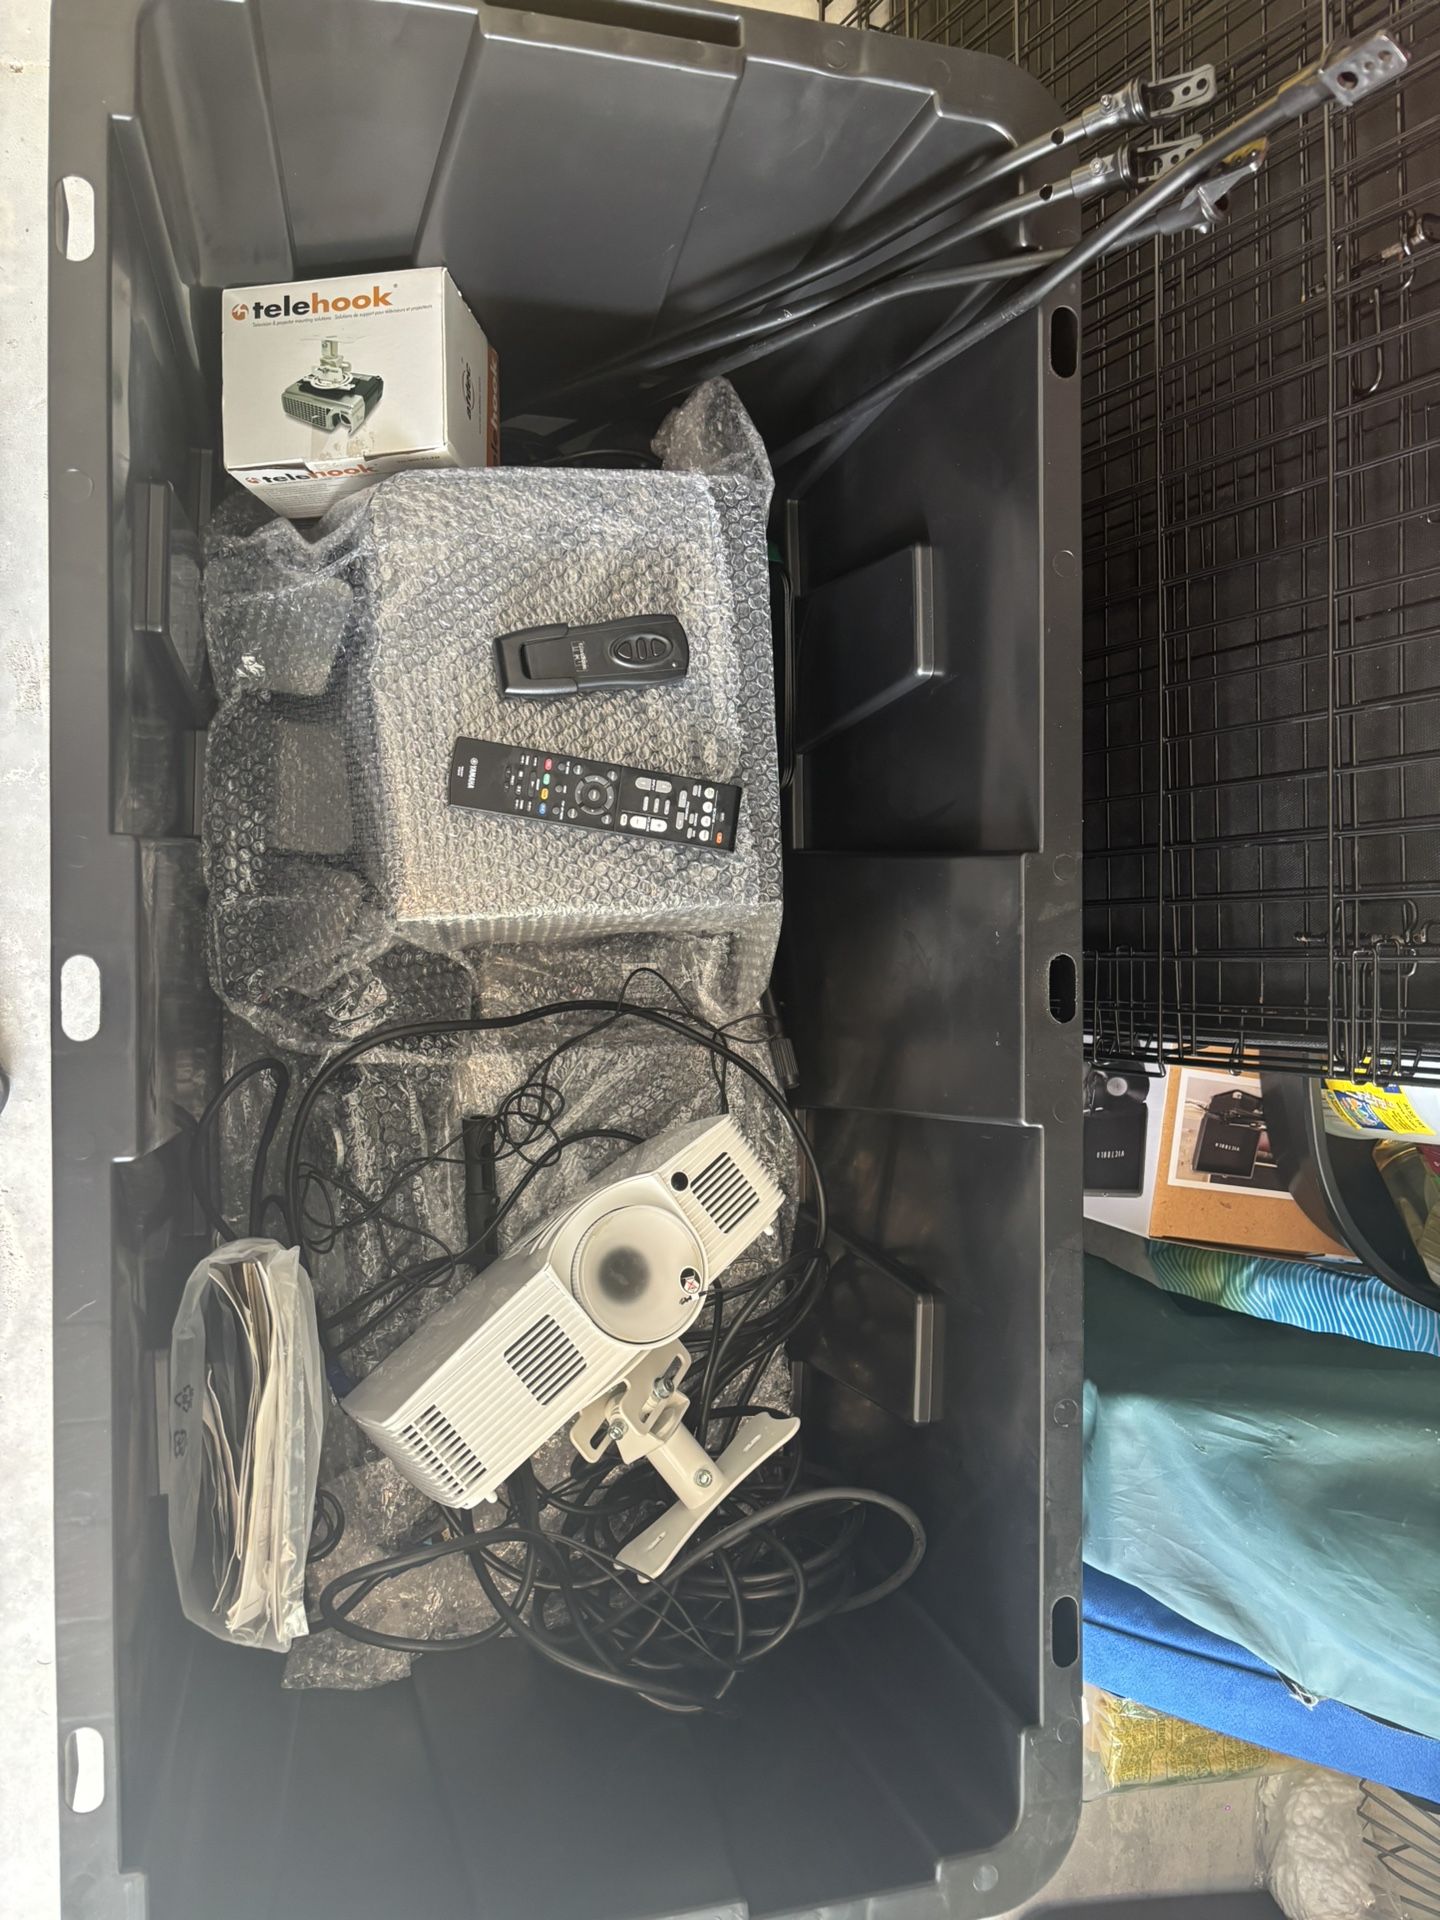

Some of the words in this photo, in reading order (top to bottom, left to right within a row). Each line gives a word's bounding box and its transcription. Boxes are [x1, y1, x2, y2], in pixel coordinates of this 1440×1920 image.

[253, 286, 393, 319] telehook
[262, 463, 376, 484] telehook
[467, 765, 477, 789] YAMAHA
[1096, 1150, 1125, 1158] VICTROLA
[1214, 1142, 1240, 1151] VICTROLA
